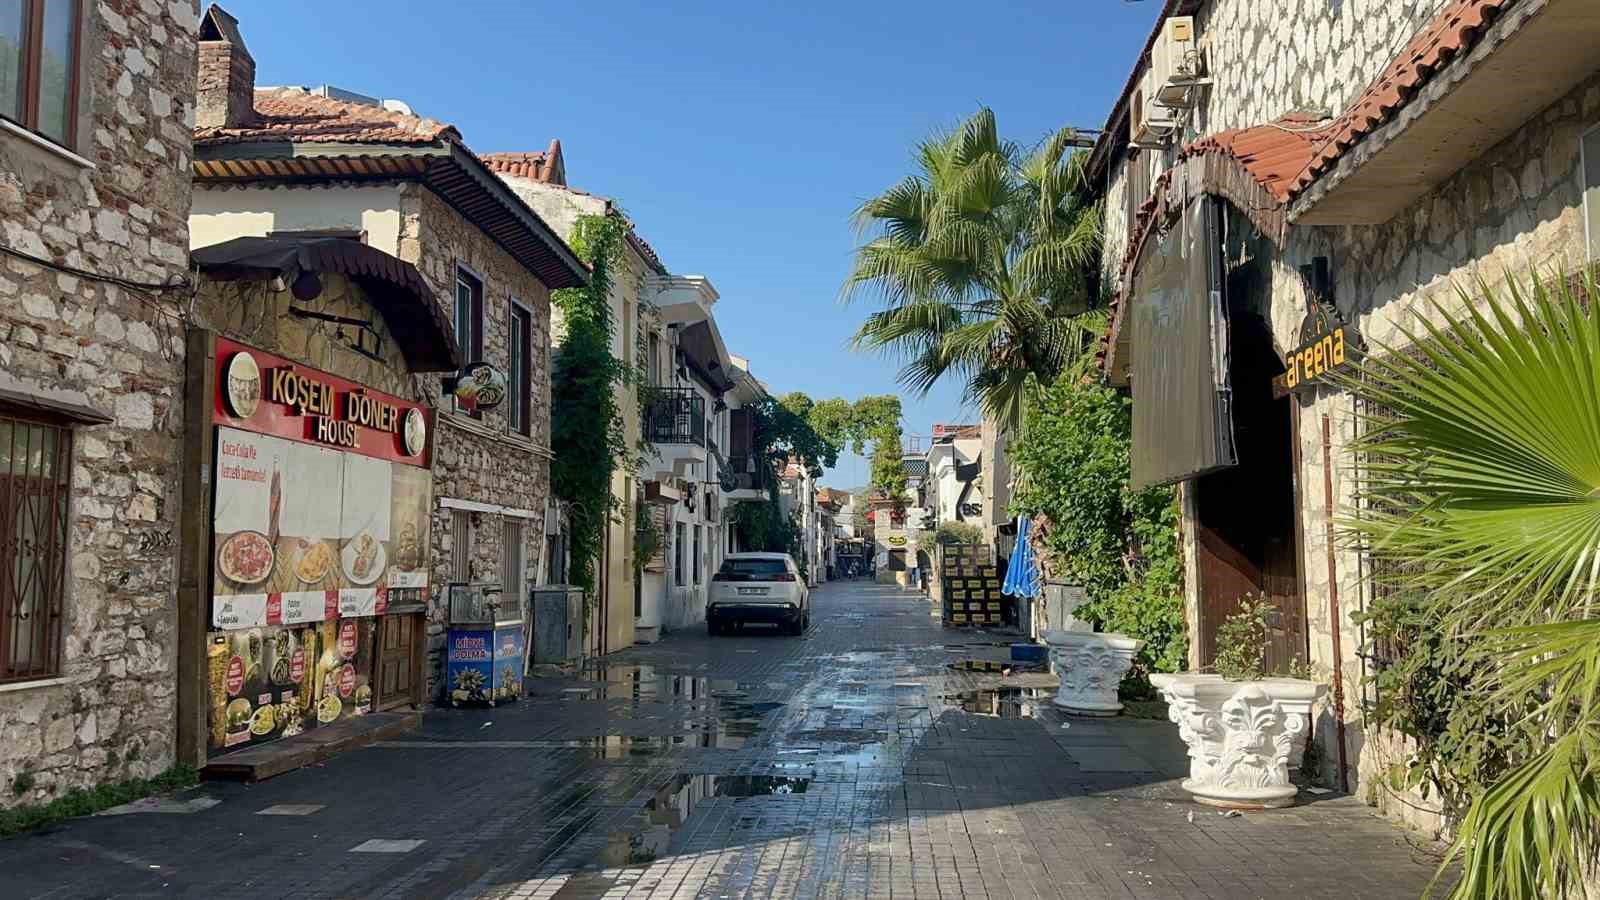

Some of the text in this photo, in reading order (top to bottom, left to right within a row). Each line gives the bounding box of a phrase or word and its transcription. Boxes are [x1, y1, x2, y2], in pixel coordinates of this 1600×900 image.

[1287, 327, 1345, 389] areena
[272, 366, 399, 433] KÖŞEM DÖNER
[318, 416, 361, 448] HOUSE
